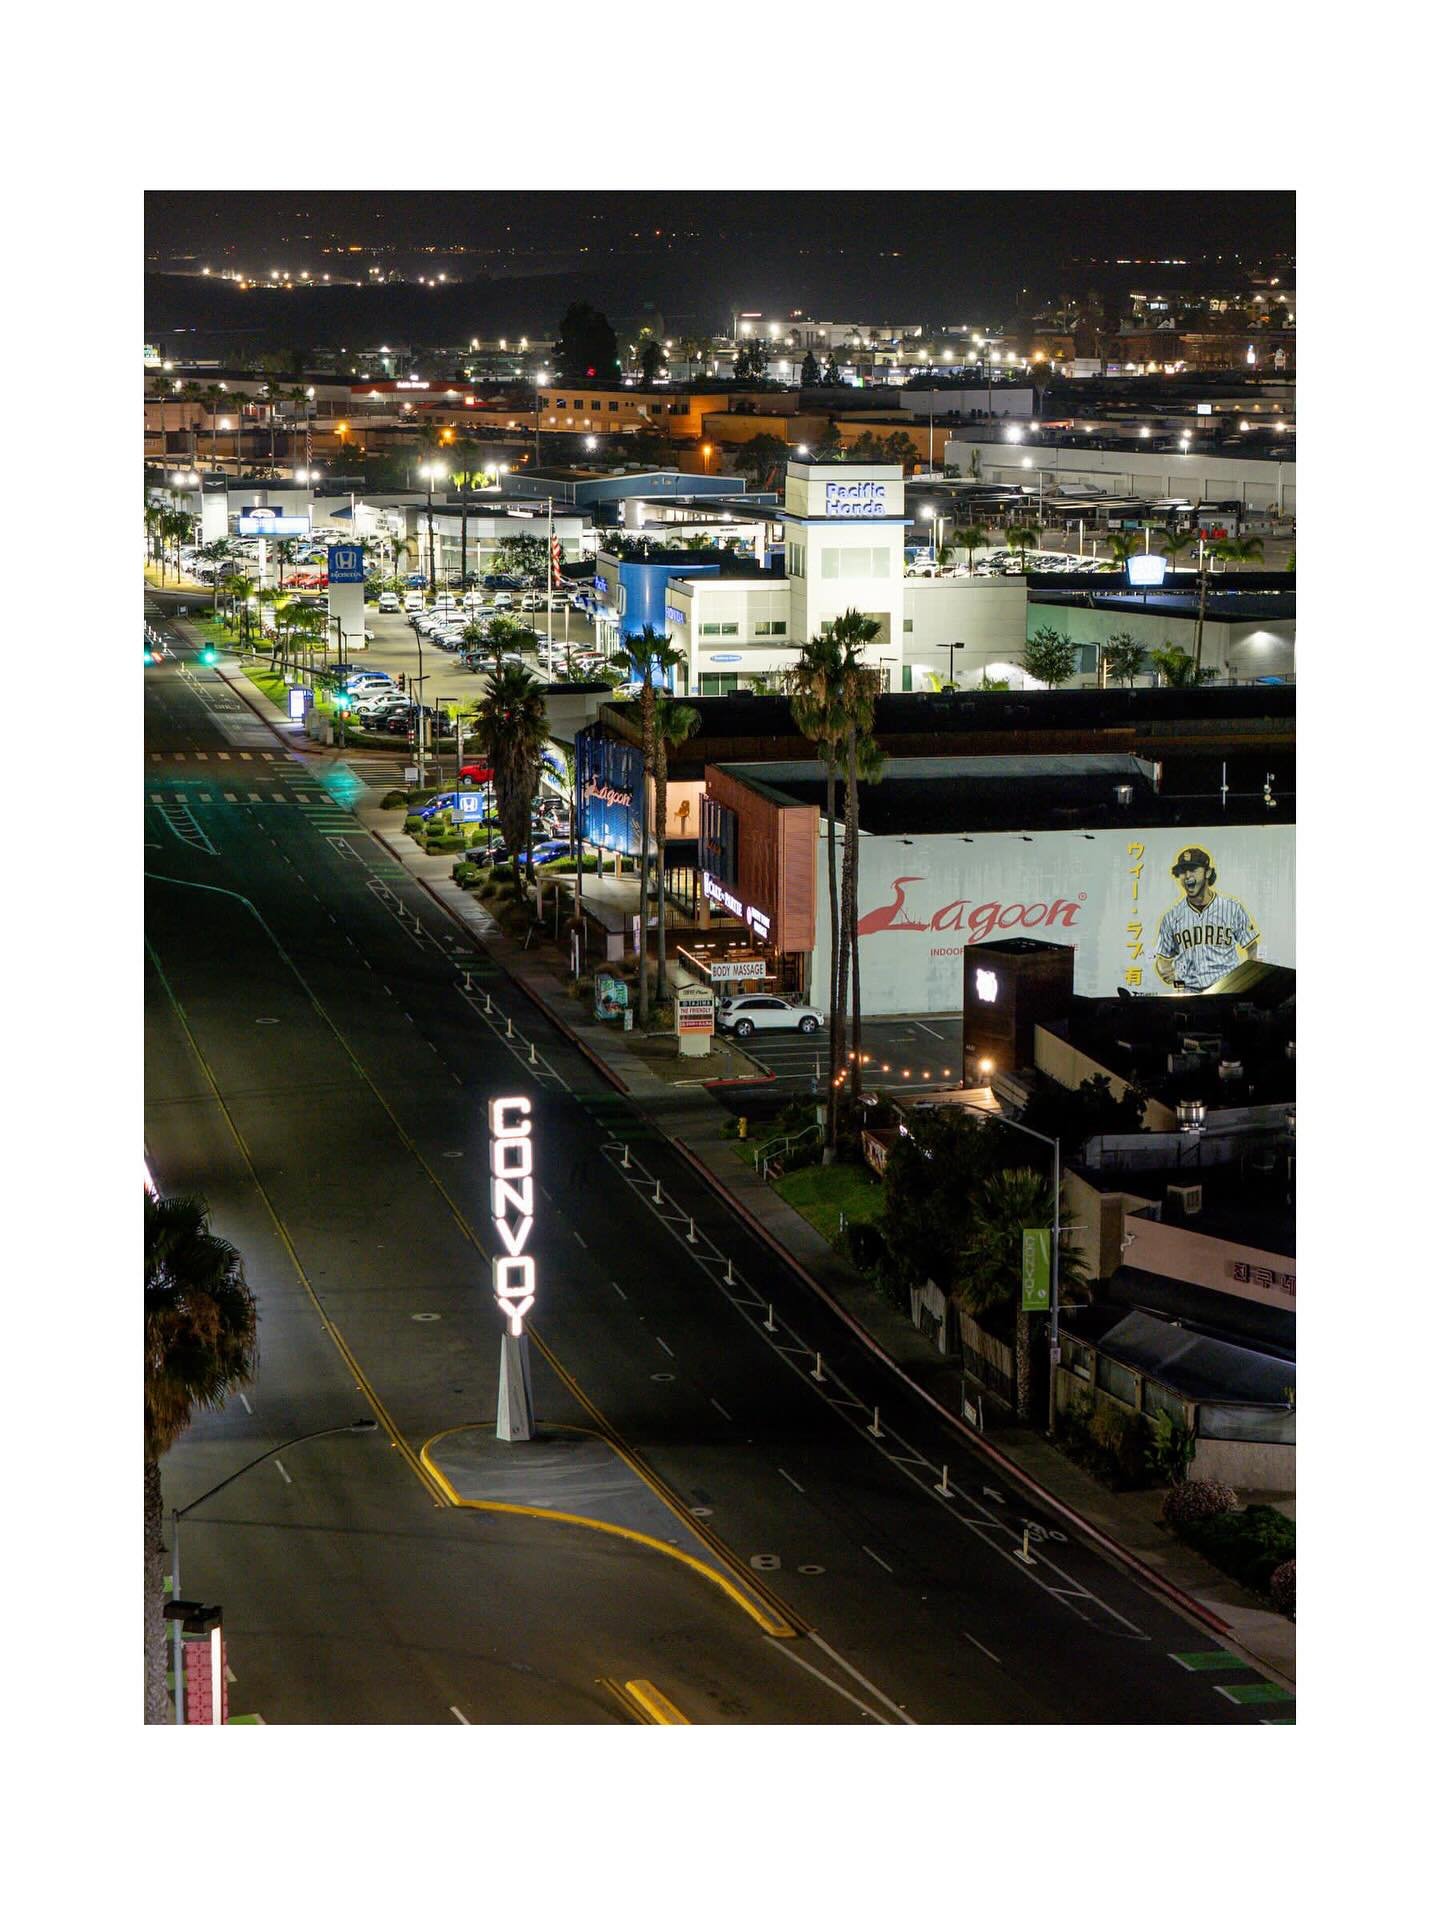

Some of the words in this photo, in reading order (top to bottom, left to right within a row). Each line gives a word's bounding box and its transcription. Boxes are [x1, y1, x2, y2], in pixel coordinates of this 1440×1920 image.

[826, 481, 886, 498] Pacific
[826, 499, 886, 515] Honda
[585, 774, 632, 807] Lagoon
[857, 876, 1081, 944] Lagoon
[1174, 925, 1234, 949] PADRES
[712, 965, 731, 977] BODY
[733, 963, 764, 976] MASSAGE
[491, 1096, 536, 1336] CONVOY
[1024, 1236, 1035, 1300] CONVOY
